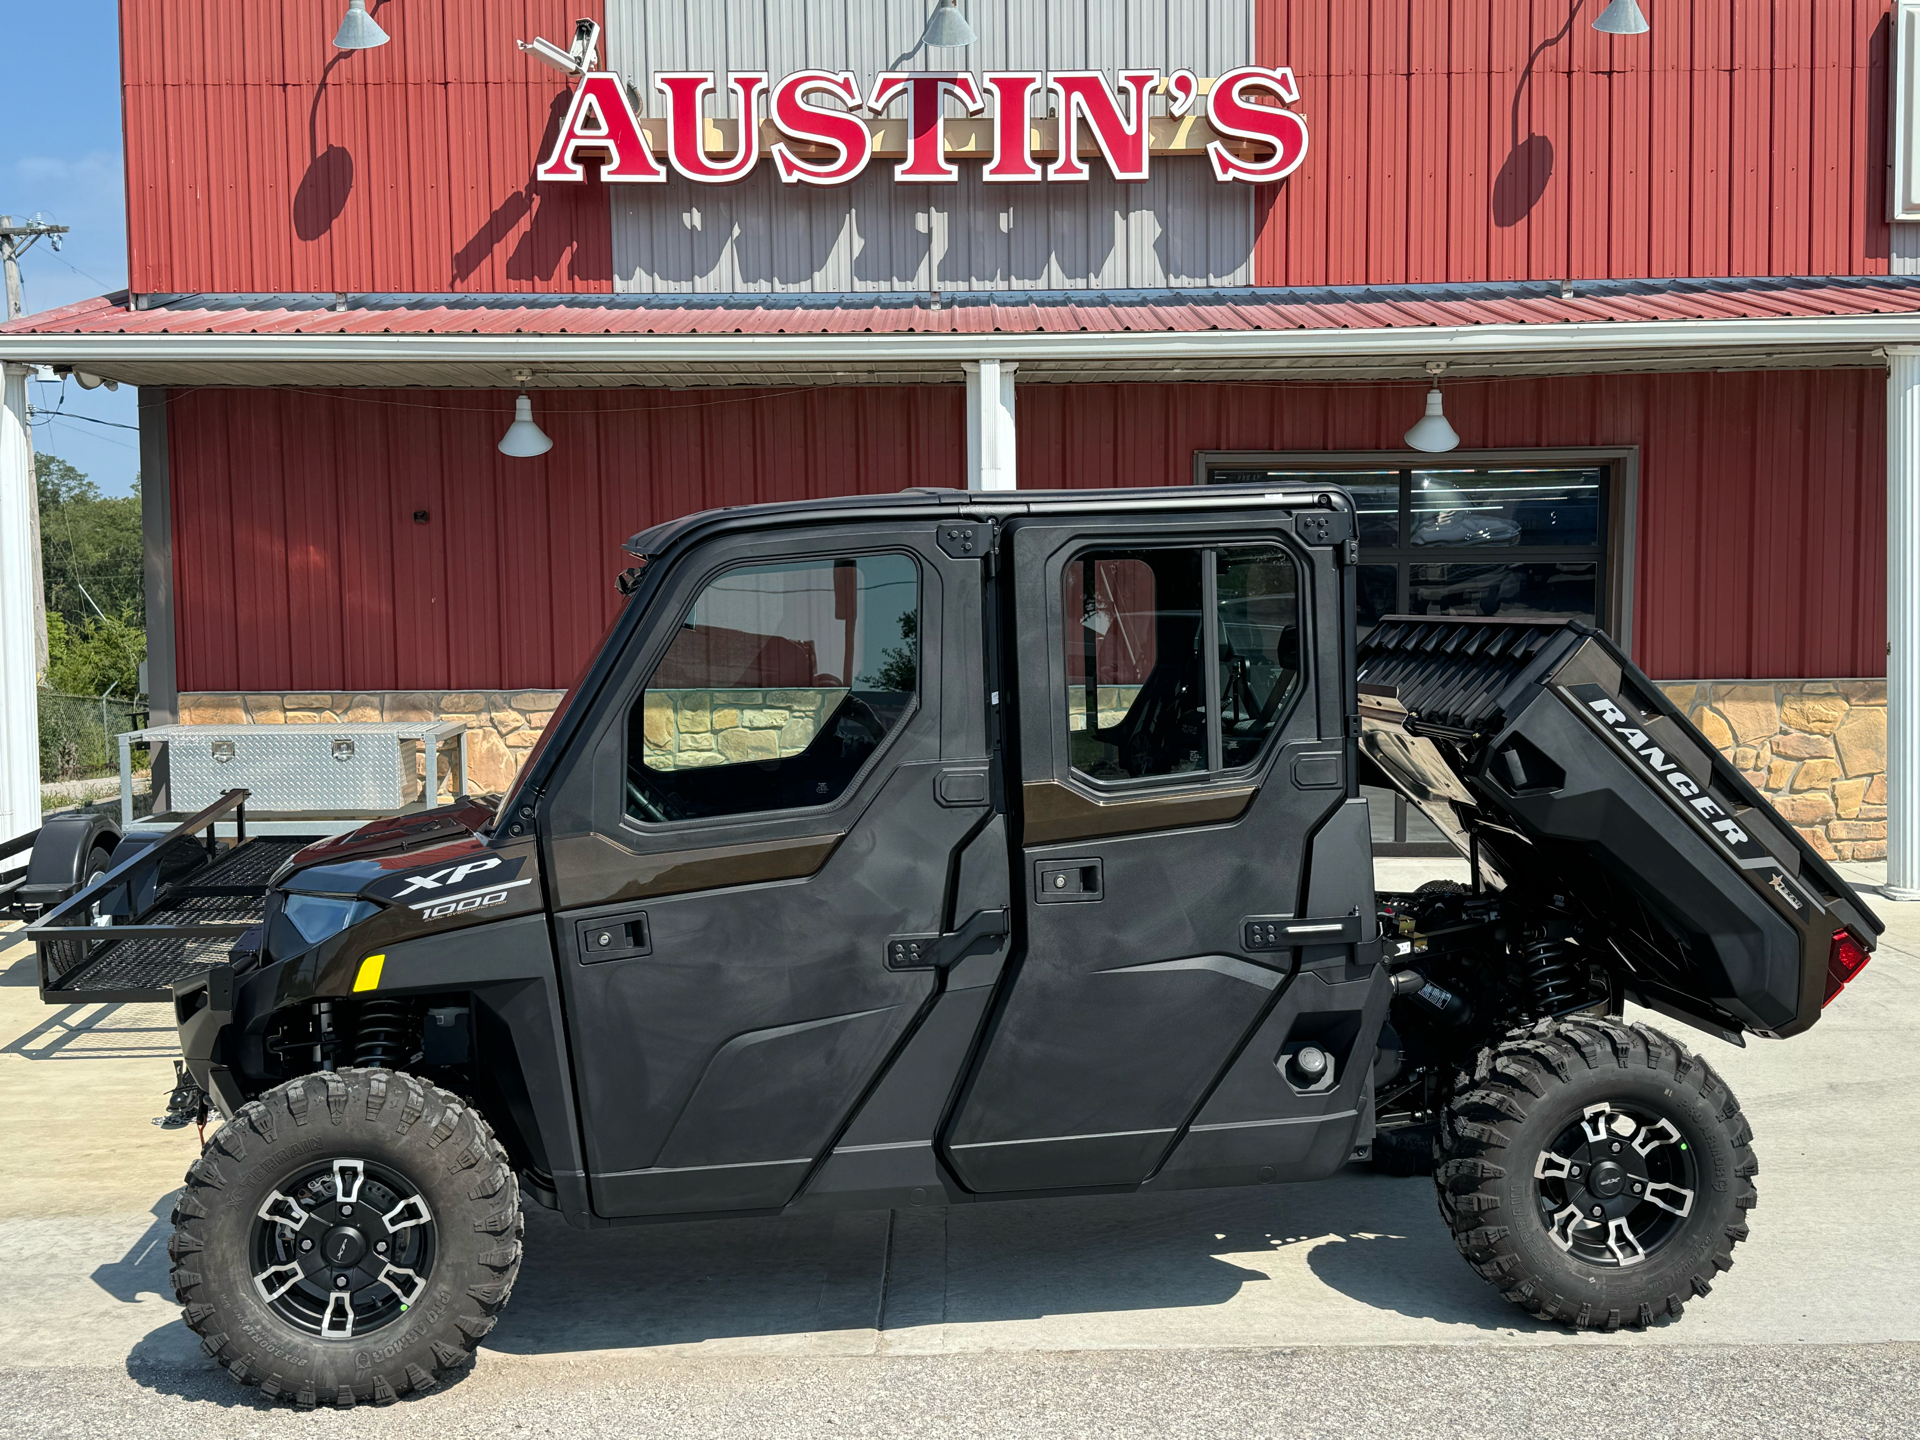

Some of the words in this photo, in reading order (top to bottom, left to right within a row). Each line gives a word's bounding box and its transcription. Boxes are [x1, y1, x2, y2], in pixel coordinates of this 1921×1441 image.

[537, 66, 1309, 184] AUSTIN'S
[1588, 698, 1749, 845] RANGER
[391, 857, 502, 899] XP
[422, 891, 508, 920] 1000
[226, 1135, 325, 1211] X-TERRAIN
[1510, 1184, 1562, 1280] X-TERRAIN
[372, 1320, 427, 1363] ARMOR
